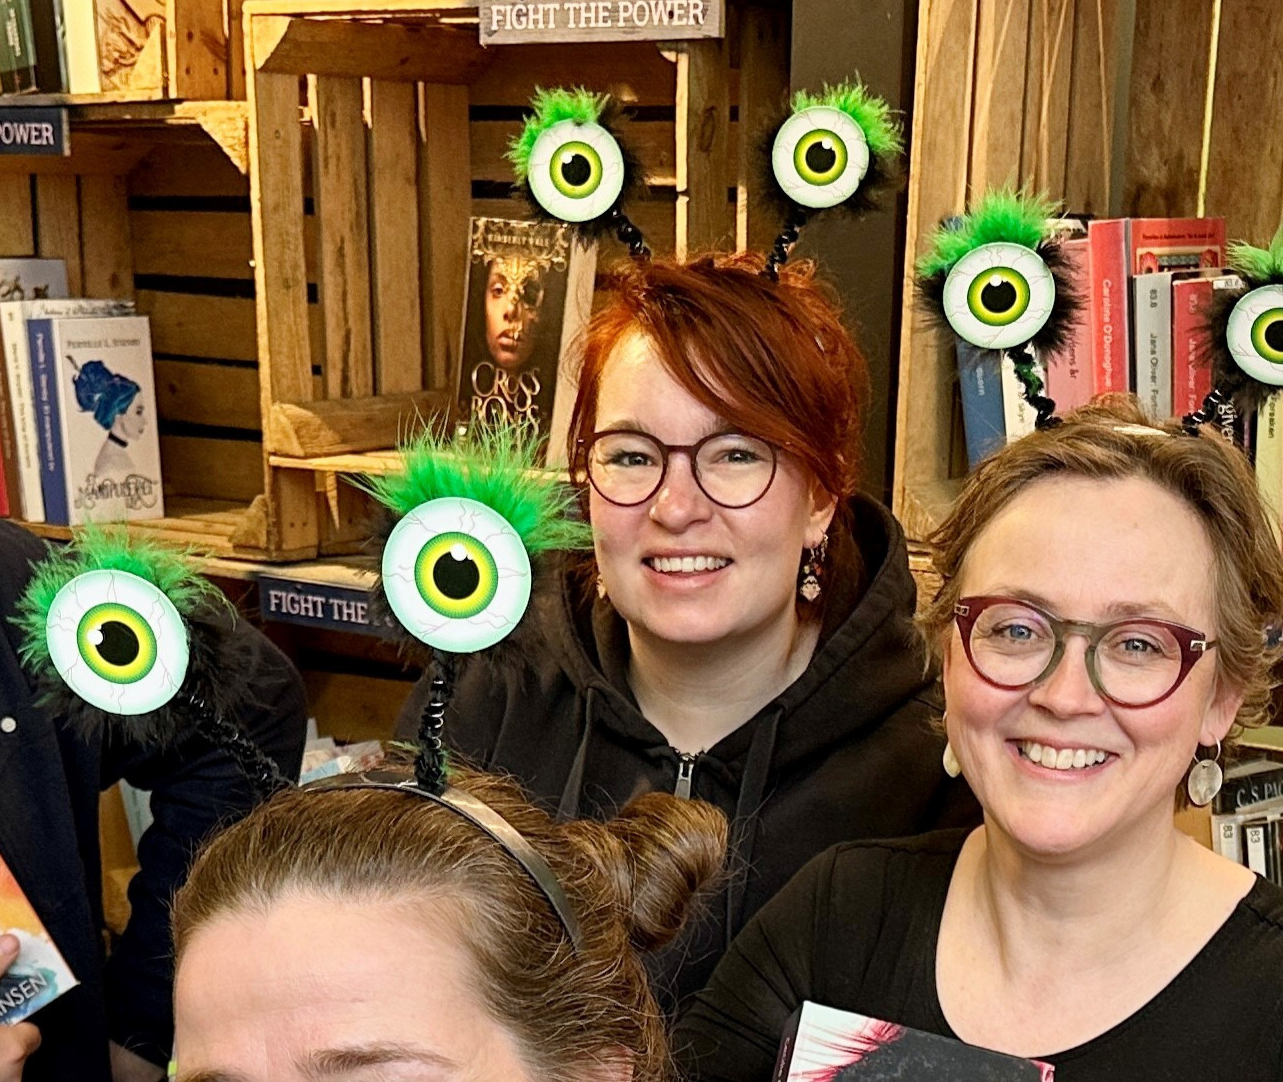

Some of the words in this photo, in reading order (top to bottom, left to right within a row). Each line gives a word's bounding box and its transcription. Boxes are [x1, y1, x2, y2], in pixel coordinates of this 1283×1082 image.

[491, 4, 560, 30] FIGHT
[564, 2, 612, 28] THE
[617, 0, 707, 27] POWER
[1102, 279, 1111, 322] Caroline
[472, 362, 540, 412] CROSS
[269, 590, 325, 618] FIGHT
[330, 599, 369, 624] THE
